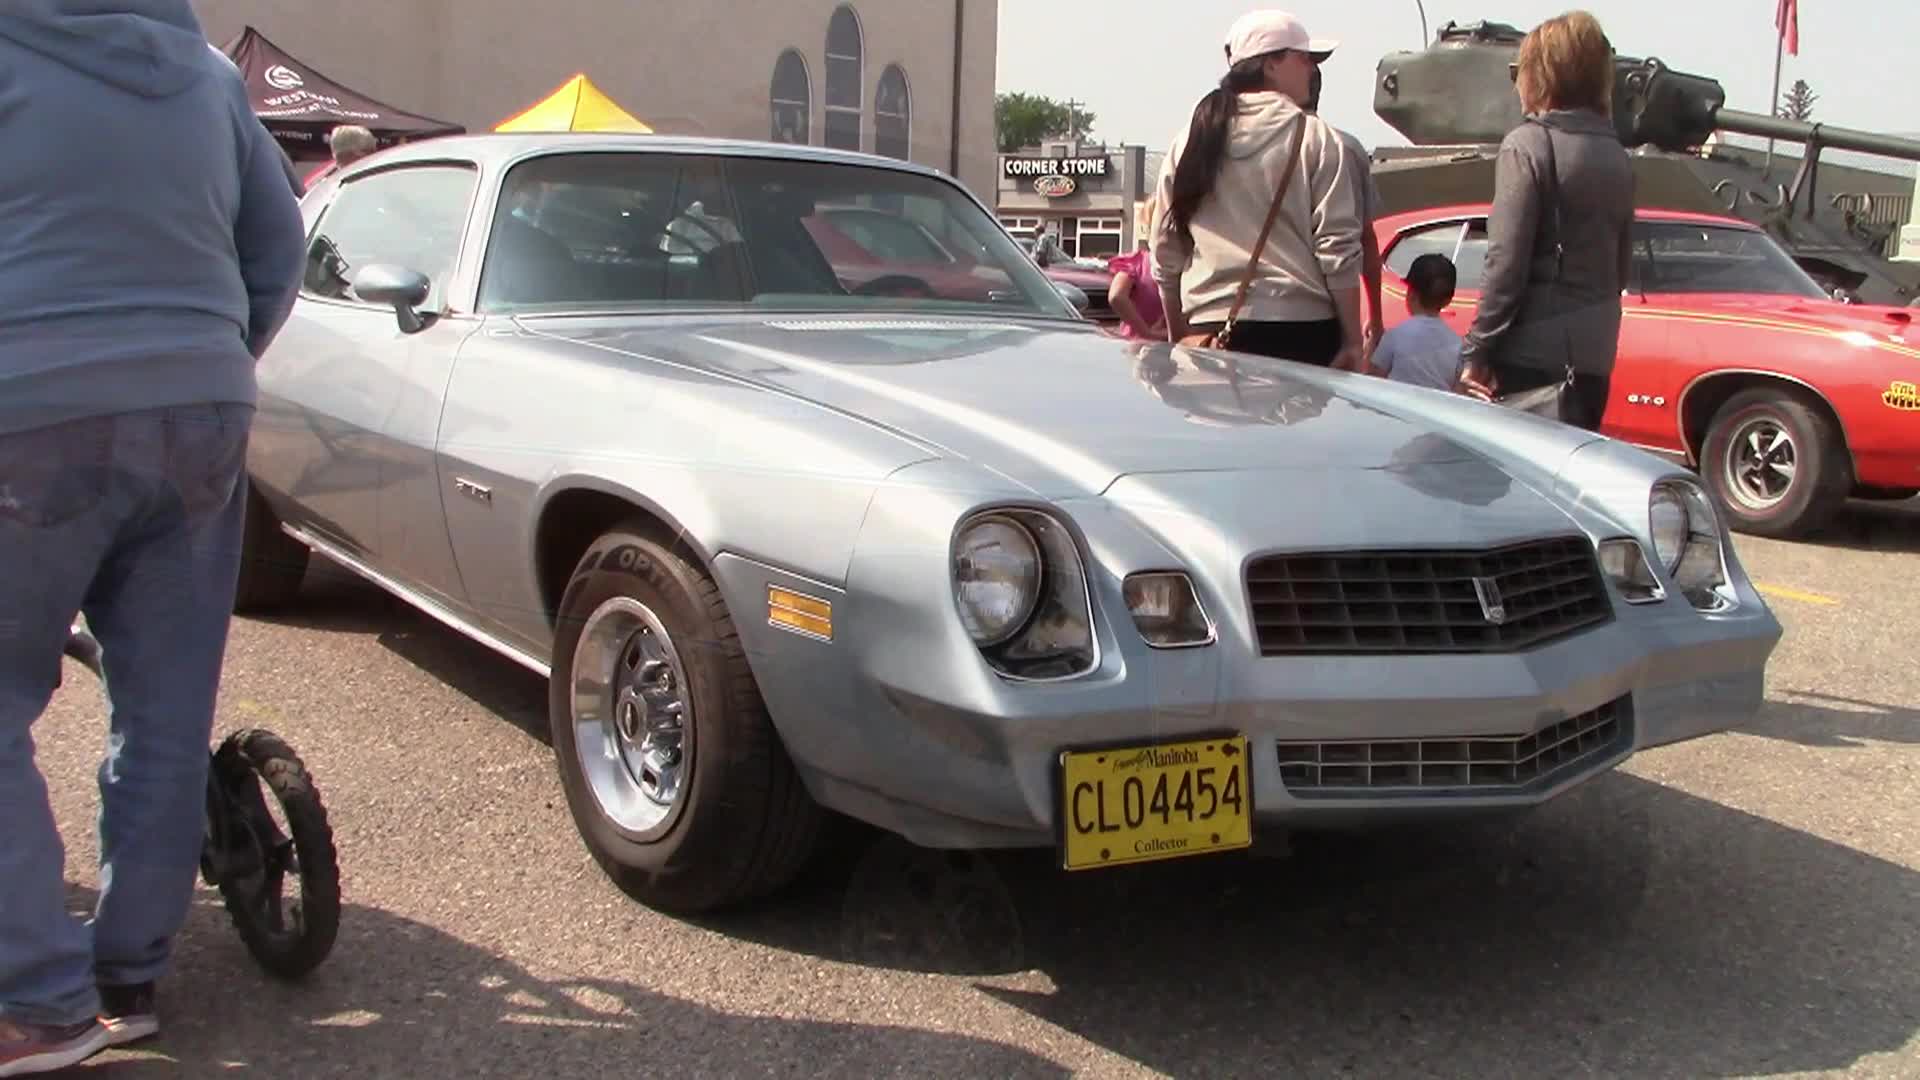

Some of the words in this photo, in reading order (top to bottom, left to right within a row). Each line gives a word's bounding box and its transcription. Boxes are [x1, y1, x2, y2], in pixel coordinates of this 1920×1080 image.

[1005, 160, 1059, 175] CORNER
[1062, 159, 1106, 174] STONE
[1627, 394, 1665, 406] GTO
[1147, 748, 1199, 769] Manitoba
[1072, 765, 1242, 834] CL04454
[1134, 837, 1188, 853] Collector
